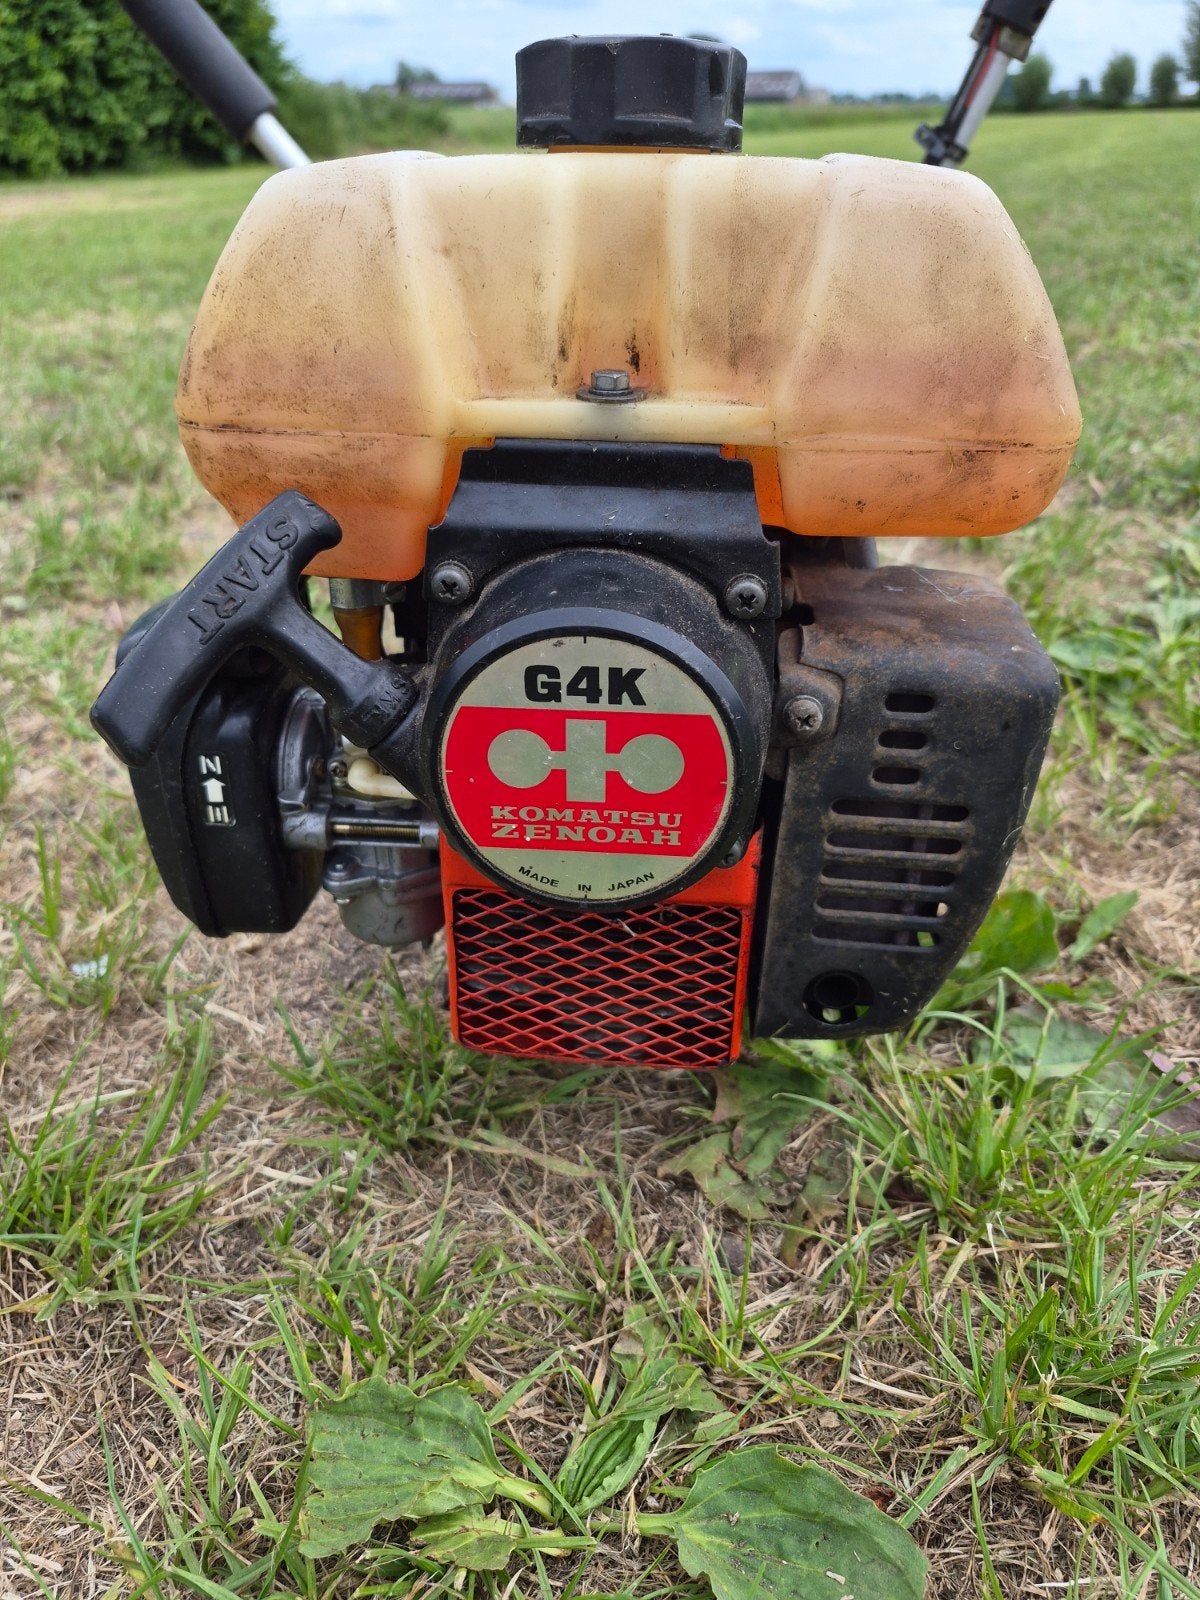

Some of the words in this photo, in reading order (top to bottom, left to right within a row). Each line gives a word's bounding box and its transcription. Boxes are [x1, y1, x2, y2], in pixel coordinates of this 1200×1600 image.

[187, 515, 299, 646] START
[524, 664, 647, 706] G4K
[490, 805, 682, 828] KOMATSU
[491, 823, 682, 846] ZENOAH
[518, 866, 560, 888] MADE
[577, 883, 592, 892] IN
[608, 872, 655, 892] JAPAN
